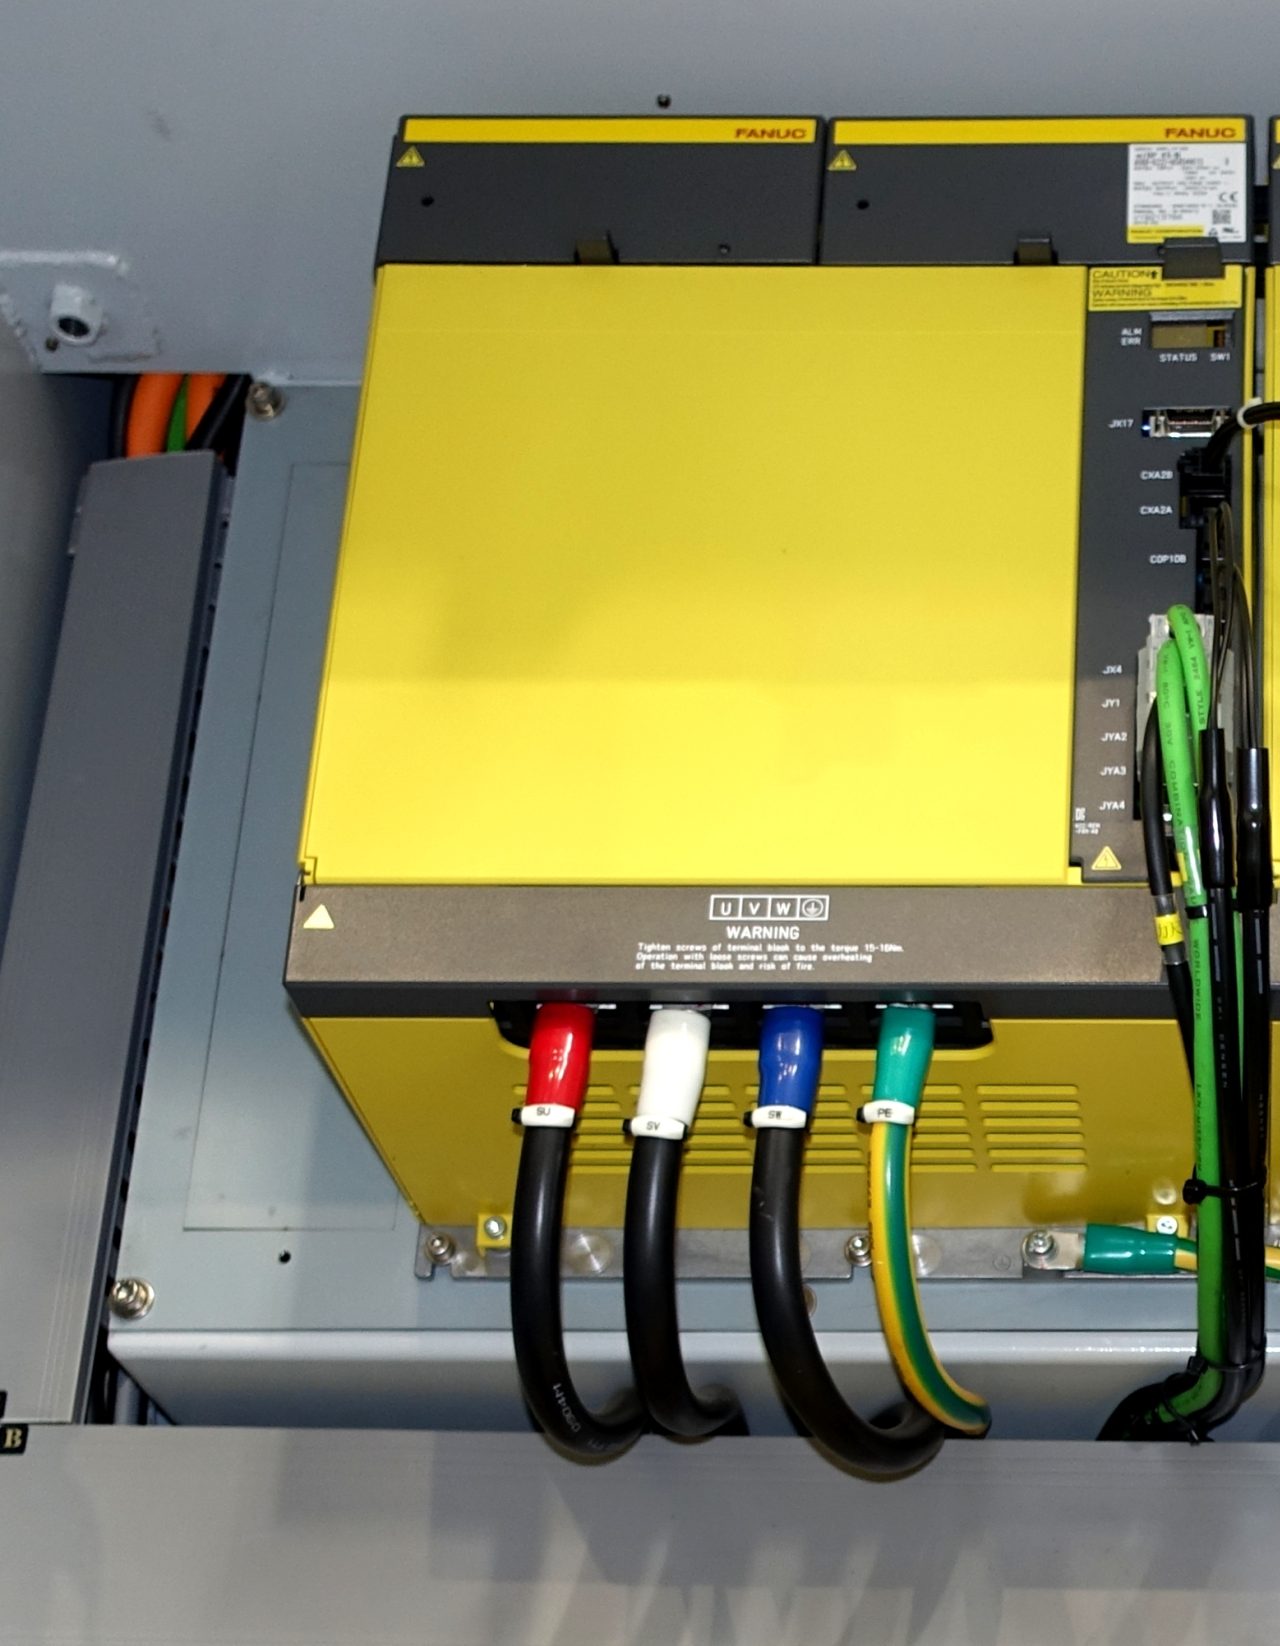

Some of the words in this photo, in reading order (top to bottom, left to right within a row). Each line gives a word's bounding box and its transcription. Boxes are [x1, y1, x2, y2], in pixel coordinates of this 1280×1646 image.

[734, 127, 807, 140] FANUC
[1164, 127, 1237, 139] FANUC
[1092, 269, 1151, 279] CAUTION
[1092, 288, 1152, 298] WARNING
[1121, 328, 1143, 336] ALM
[1120, 337, 1142, 346] ERR
[1159, 353, 1198, 363] STATUS
[1209, 352, 1231, 362] SW1
[1108, 419, 1134, 428] JX17
[1139, 505, 1173, 515] CXA2A
[1101, 699, 1121, 708] JY1
[1100, 732, 1128, 742] JYA2
[1100, 766, 1127, 776] JYA3
[1099, 801, 1126, 810] JYA4
[720, 902, 732, 916] U
[749, 902, 761, 915] V
[776, 902, 791, 915] W
[726, 926, 800, 939] WARNING
[638, 943, 671, 952] Tighten
[676, 943, 707, 952] screws
[712, 943, 722, 952] of
[727, 943, 762, 952] terminal
[796, 943, 805, 952] to
[810, 943, 825, 952] the
[831, 943, 859, 952] torque
[636, 953, 678, 962] Operation
[683, 953, 704, 962] with
[710, 953, 731, 962] loose
[737, 953, 768, 962] screws
[773, 953, 788, 962] can
[793, 953, 817, 962] cause
[823, 953, 872, 962] overheating
[636, 962, 646, 970] of
[651, 962, 665, 970] the
[671, 962, 706, 970] terminal
[739, 962, 754, 970] and
[759, 962, 776, 970] risk
[781, 962, 791, 970] of
[796, 962, 815, 970] fire.
[537, 1107, 551, 1116] SU
[768, 1110, 783, 1119] SW
[877, 1108, 892, 1118] PE
[646, 1121, 660, 1131] SV
[3, 1428, 22, 1448] B
